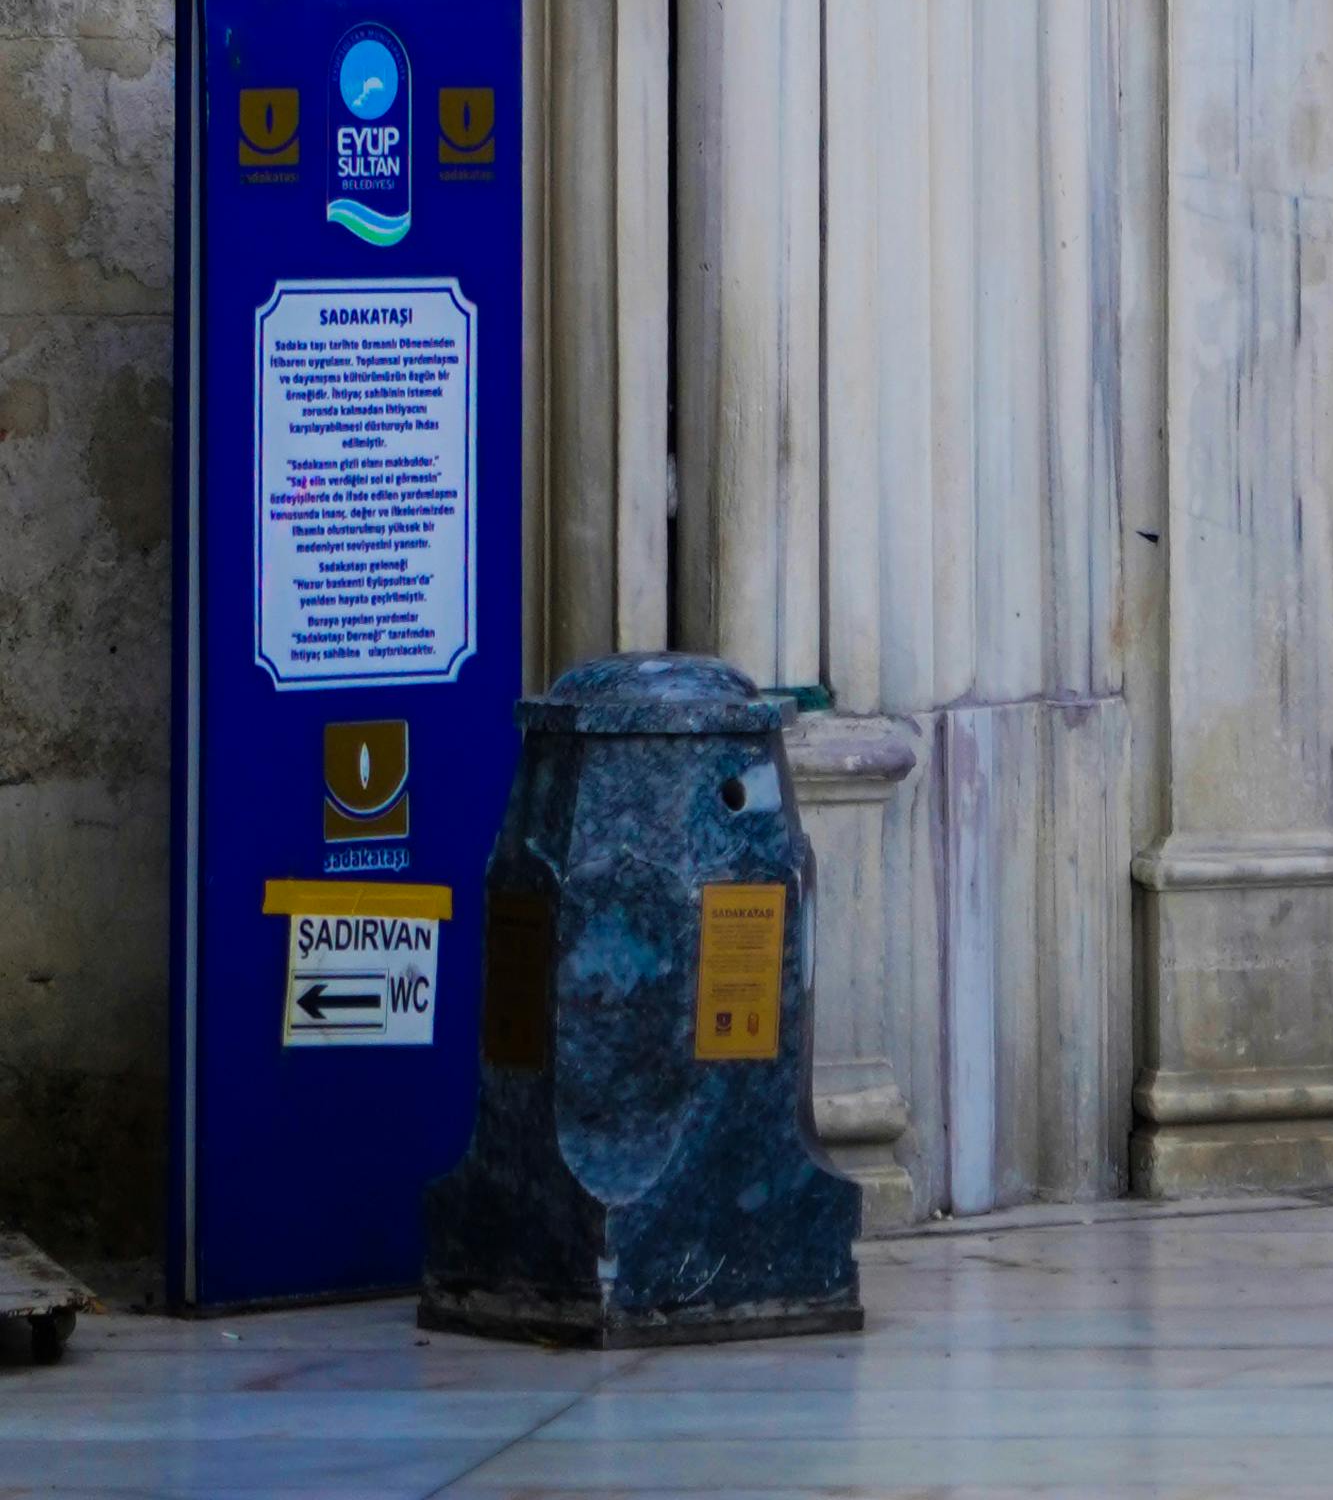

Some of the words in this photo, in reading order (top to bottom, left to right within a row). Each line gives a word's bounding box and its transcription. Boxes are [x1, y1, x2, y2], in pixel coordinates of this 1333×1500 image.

[336, 126, 400, 156] EYÜP
[337, 156, 401, 178] SULTAN
[320, 308, 413, 327] SADAKATAŞI
[275, 340, 307, 350] Sadaka
[329, 339, 358, 349] tarihte
[361, 338, 397, 349] Osmanlı
[399, 337, 455, 348] Döneminden
[279, 375, 290, 384] ve
[409, 371, 436, 383] özgün
[438, 371, 450, 381] bir
[364, 388, 405, 398] sahibinin
[407, 387, 443, 397] istemek
[302, 405, 338, 416] zorunda
[340, 404, 383, 416] kalmadan
[310, 475, 326, 486] elin
[371, 474, 383, 484] sol
[386, 474, 394, 484] el
[333, 491, 344, 502] de
[371, 490, 399, 500] edilen
[270, 509, 319, 520] konusunda
[378, 508, 389, 517] ve
[388, 523, 420, 533] yüksek
[423, 522, 434, 532] bir
[296, 542, 344, 553] medeniyet
[300, 596, 336, 608] yeniden
[338, 595, 368, 607] hayata
[323, 845, 410, 872] sadakataşı
[297, 919, 432, 960] ŞADIRVAN
[390, 976, 430, 1013] WC
